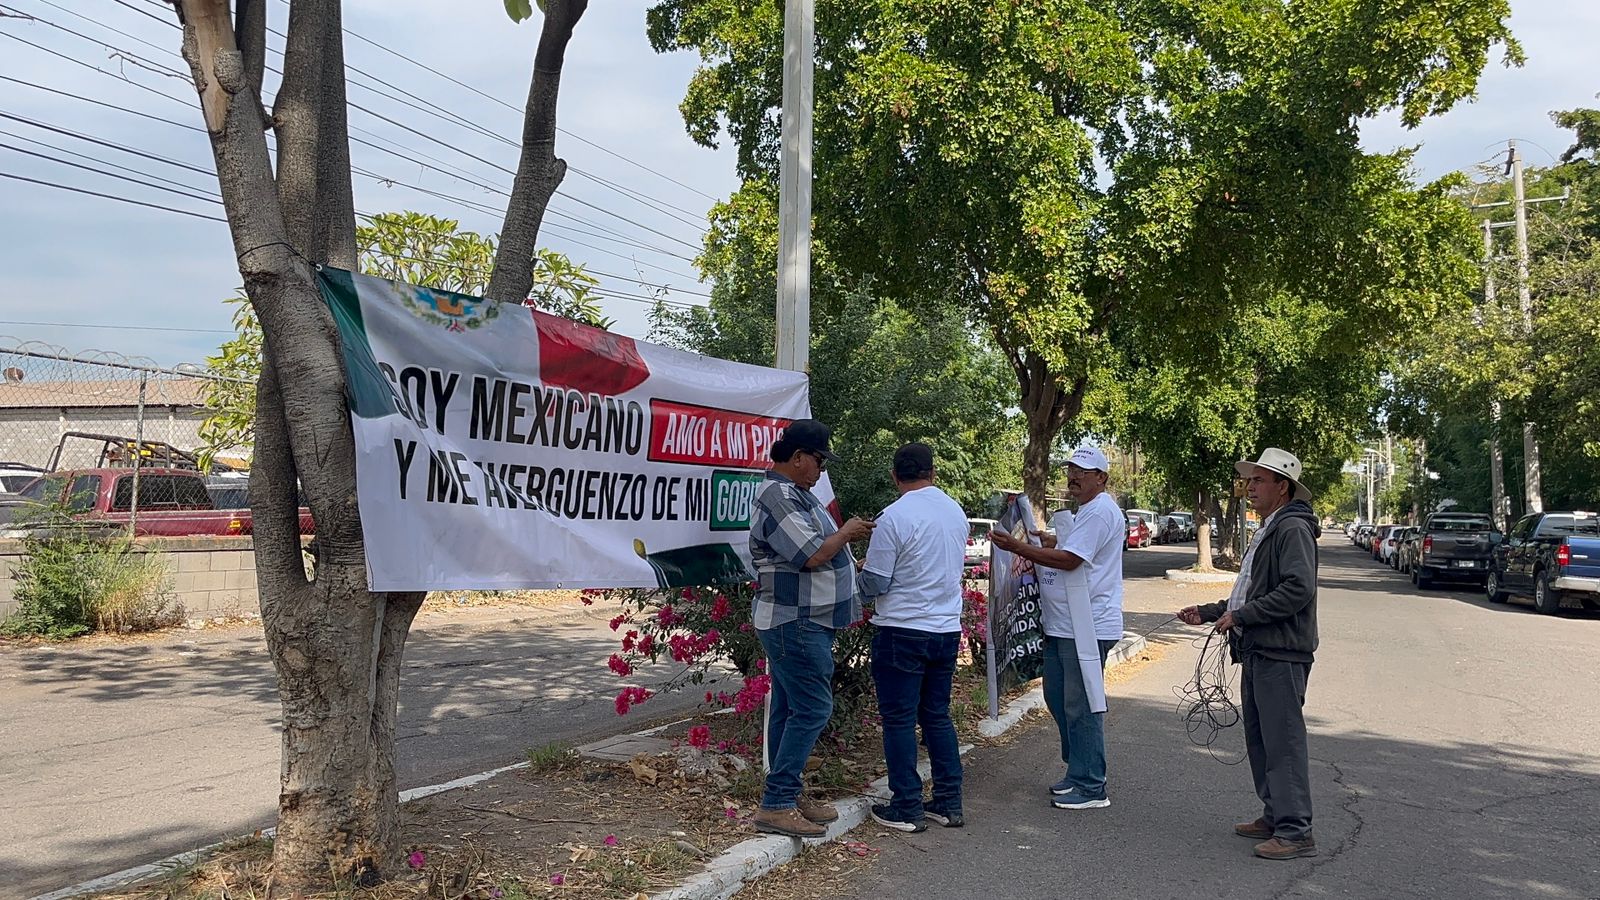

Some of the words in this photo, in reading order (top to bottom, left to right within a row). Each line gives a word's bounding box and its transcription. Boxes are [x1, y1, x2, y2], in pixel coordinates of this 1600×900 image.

[469, 376, 643, 455] MEXICANO
[661, 412, 707, 457] AMO
[710, 419, 723, 458] A
[726, 421, 748, 460] MI
[394, 438, 417, 500] Y
[427, 444, 478, 505] ME
[473, 461, 647, 521] AVERGUENZO
[652, 475, 681, 520] DE
[685, 477, 708, 521] MI
[716, 479, 760, 521] GOBI
